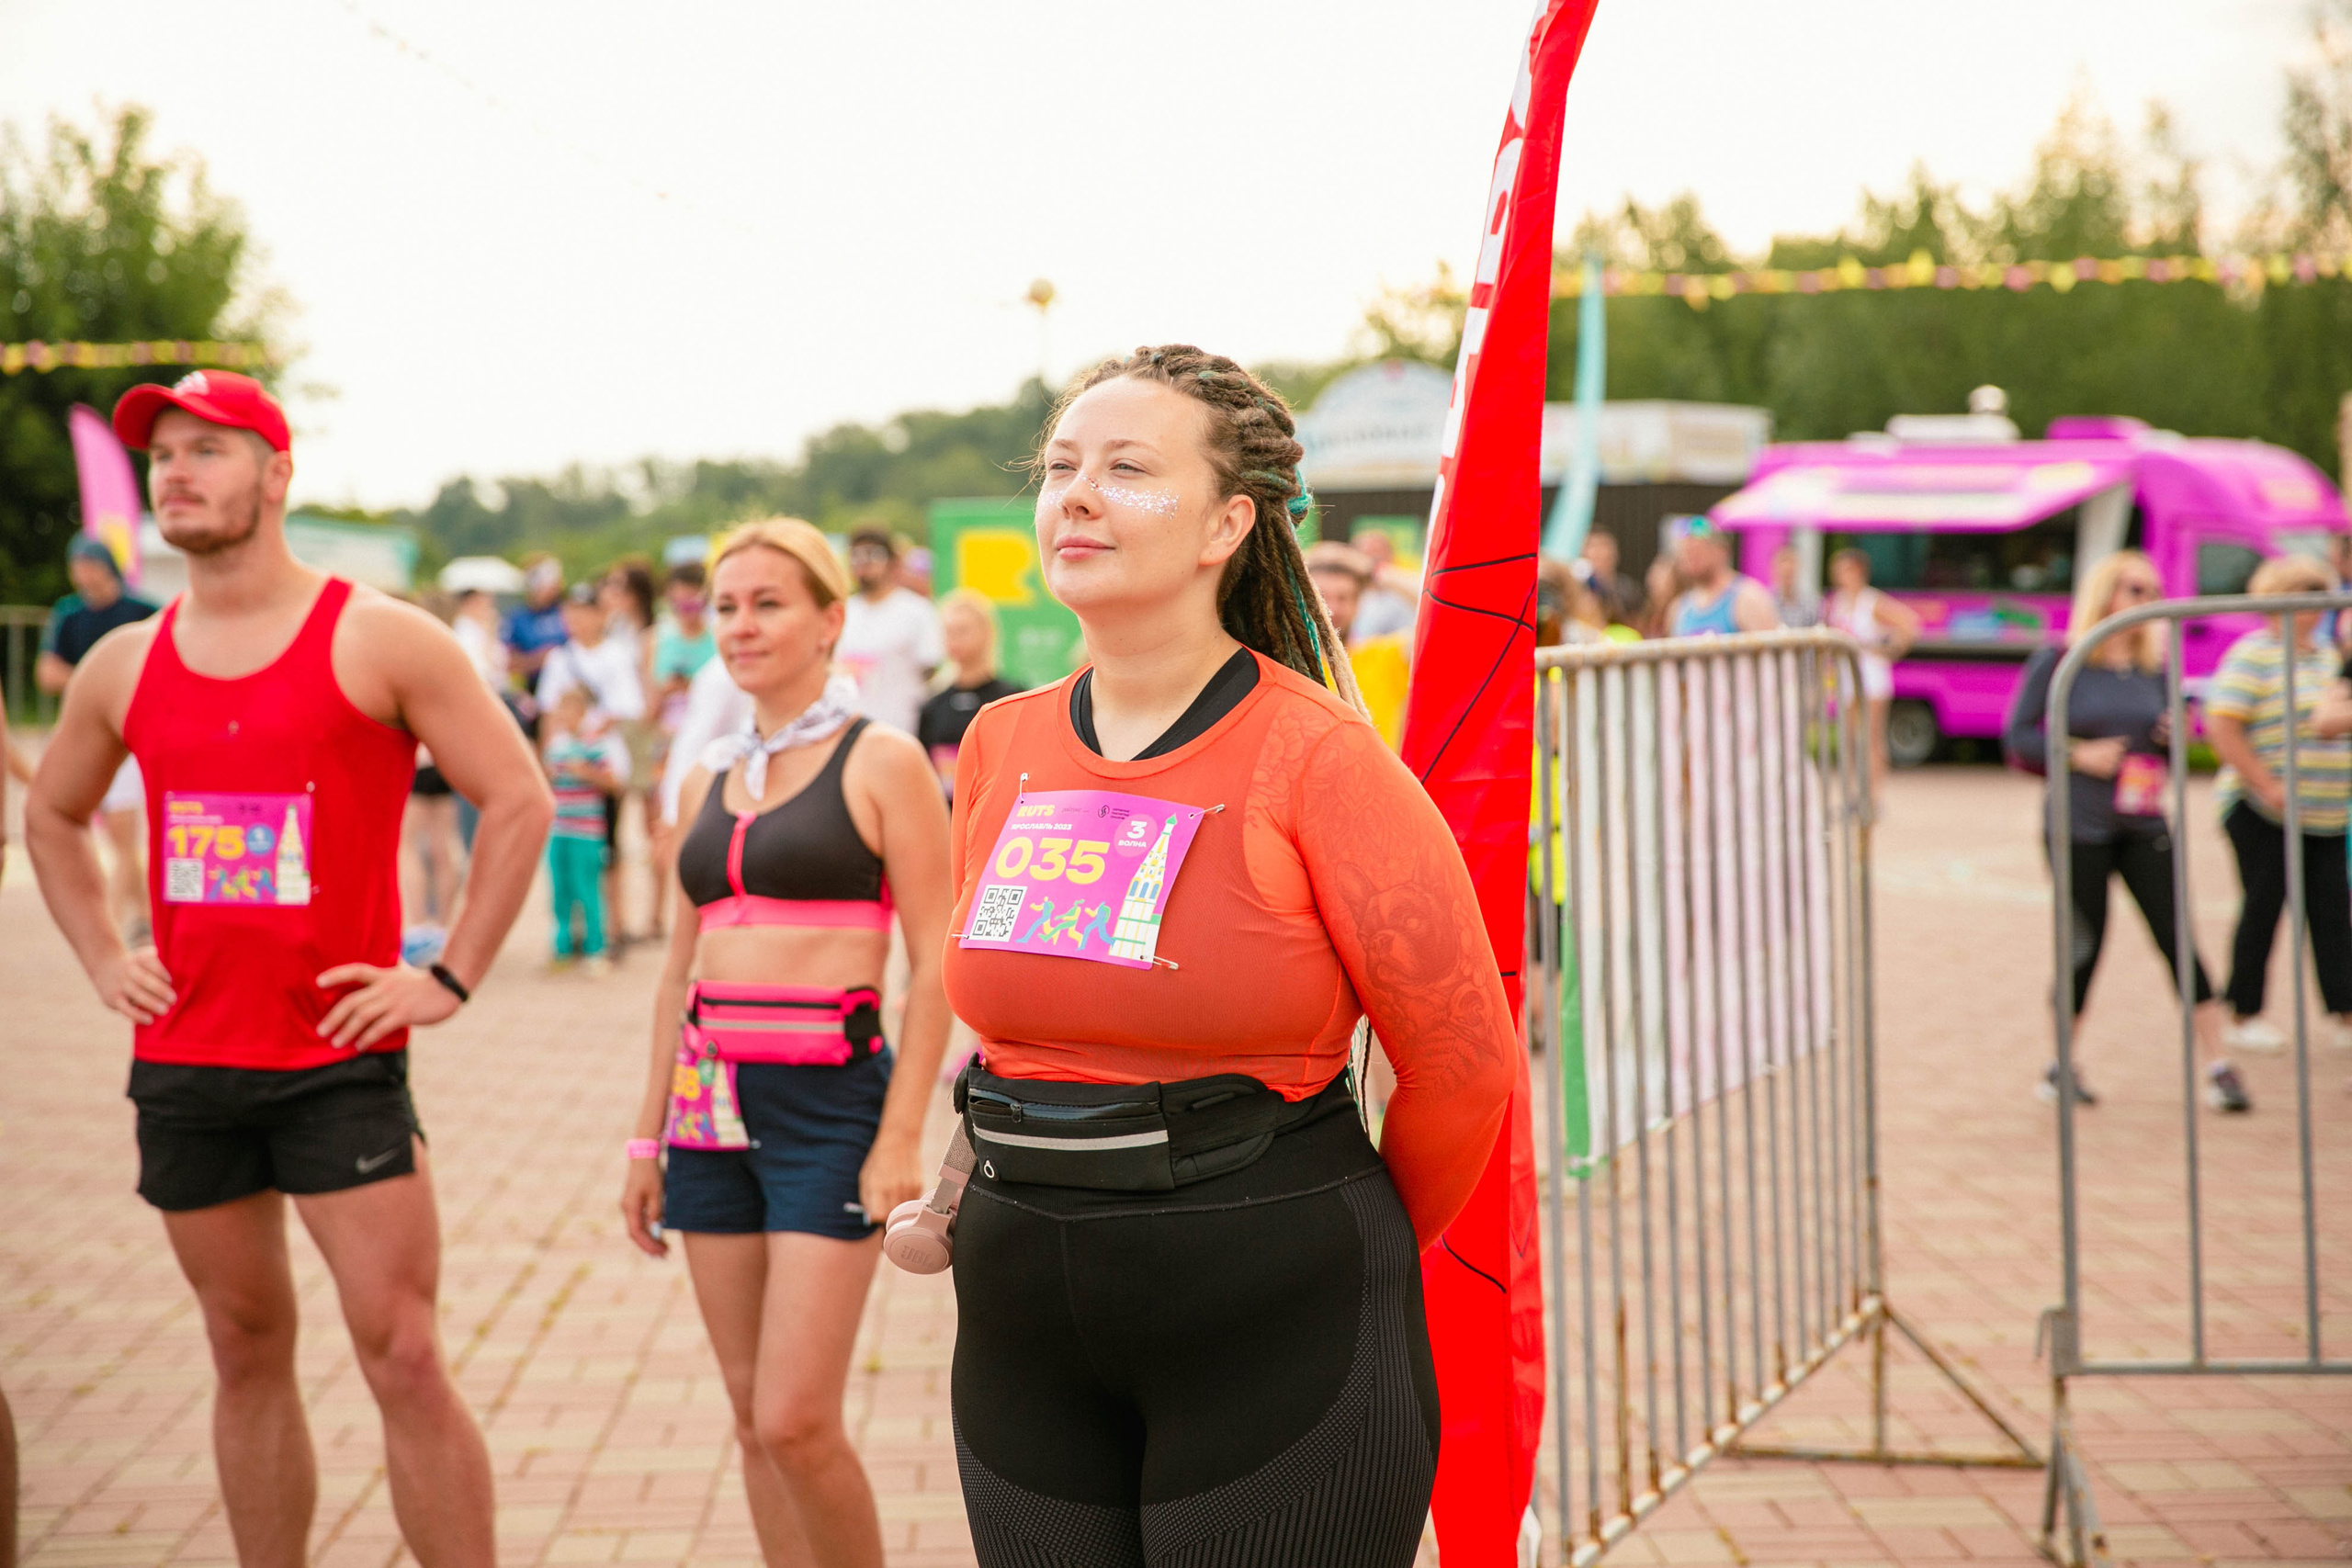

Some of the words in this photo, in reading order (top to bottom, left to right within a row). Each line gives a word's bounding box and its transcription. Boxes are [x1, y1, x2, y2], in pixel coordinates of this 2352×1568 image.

[1017, 805, 1055, 818] RUTS
[1127, 820, 1147, 839] 3
[168, 825, 245, 860] 175
[1118, 840, 1147, 848] ВОЛНА
[996, 837, 1110, 885] 035
